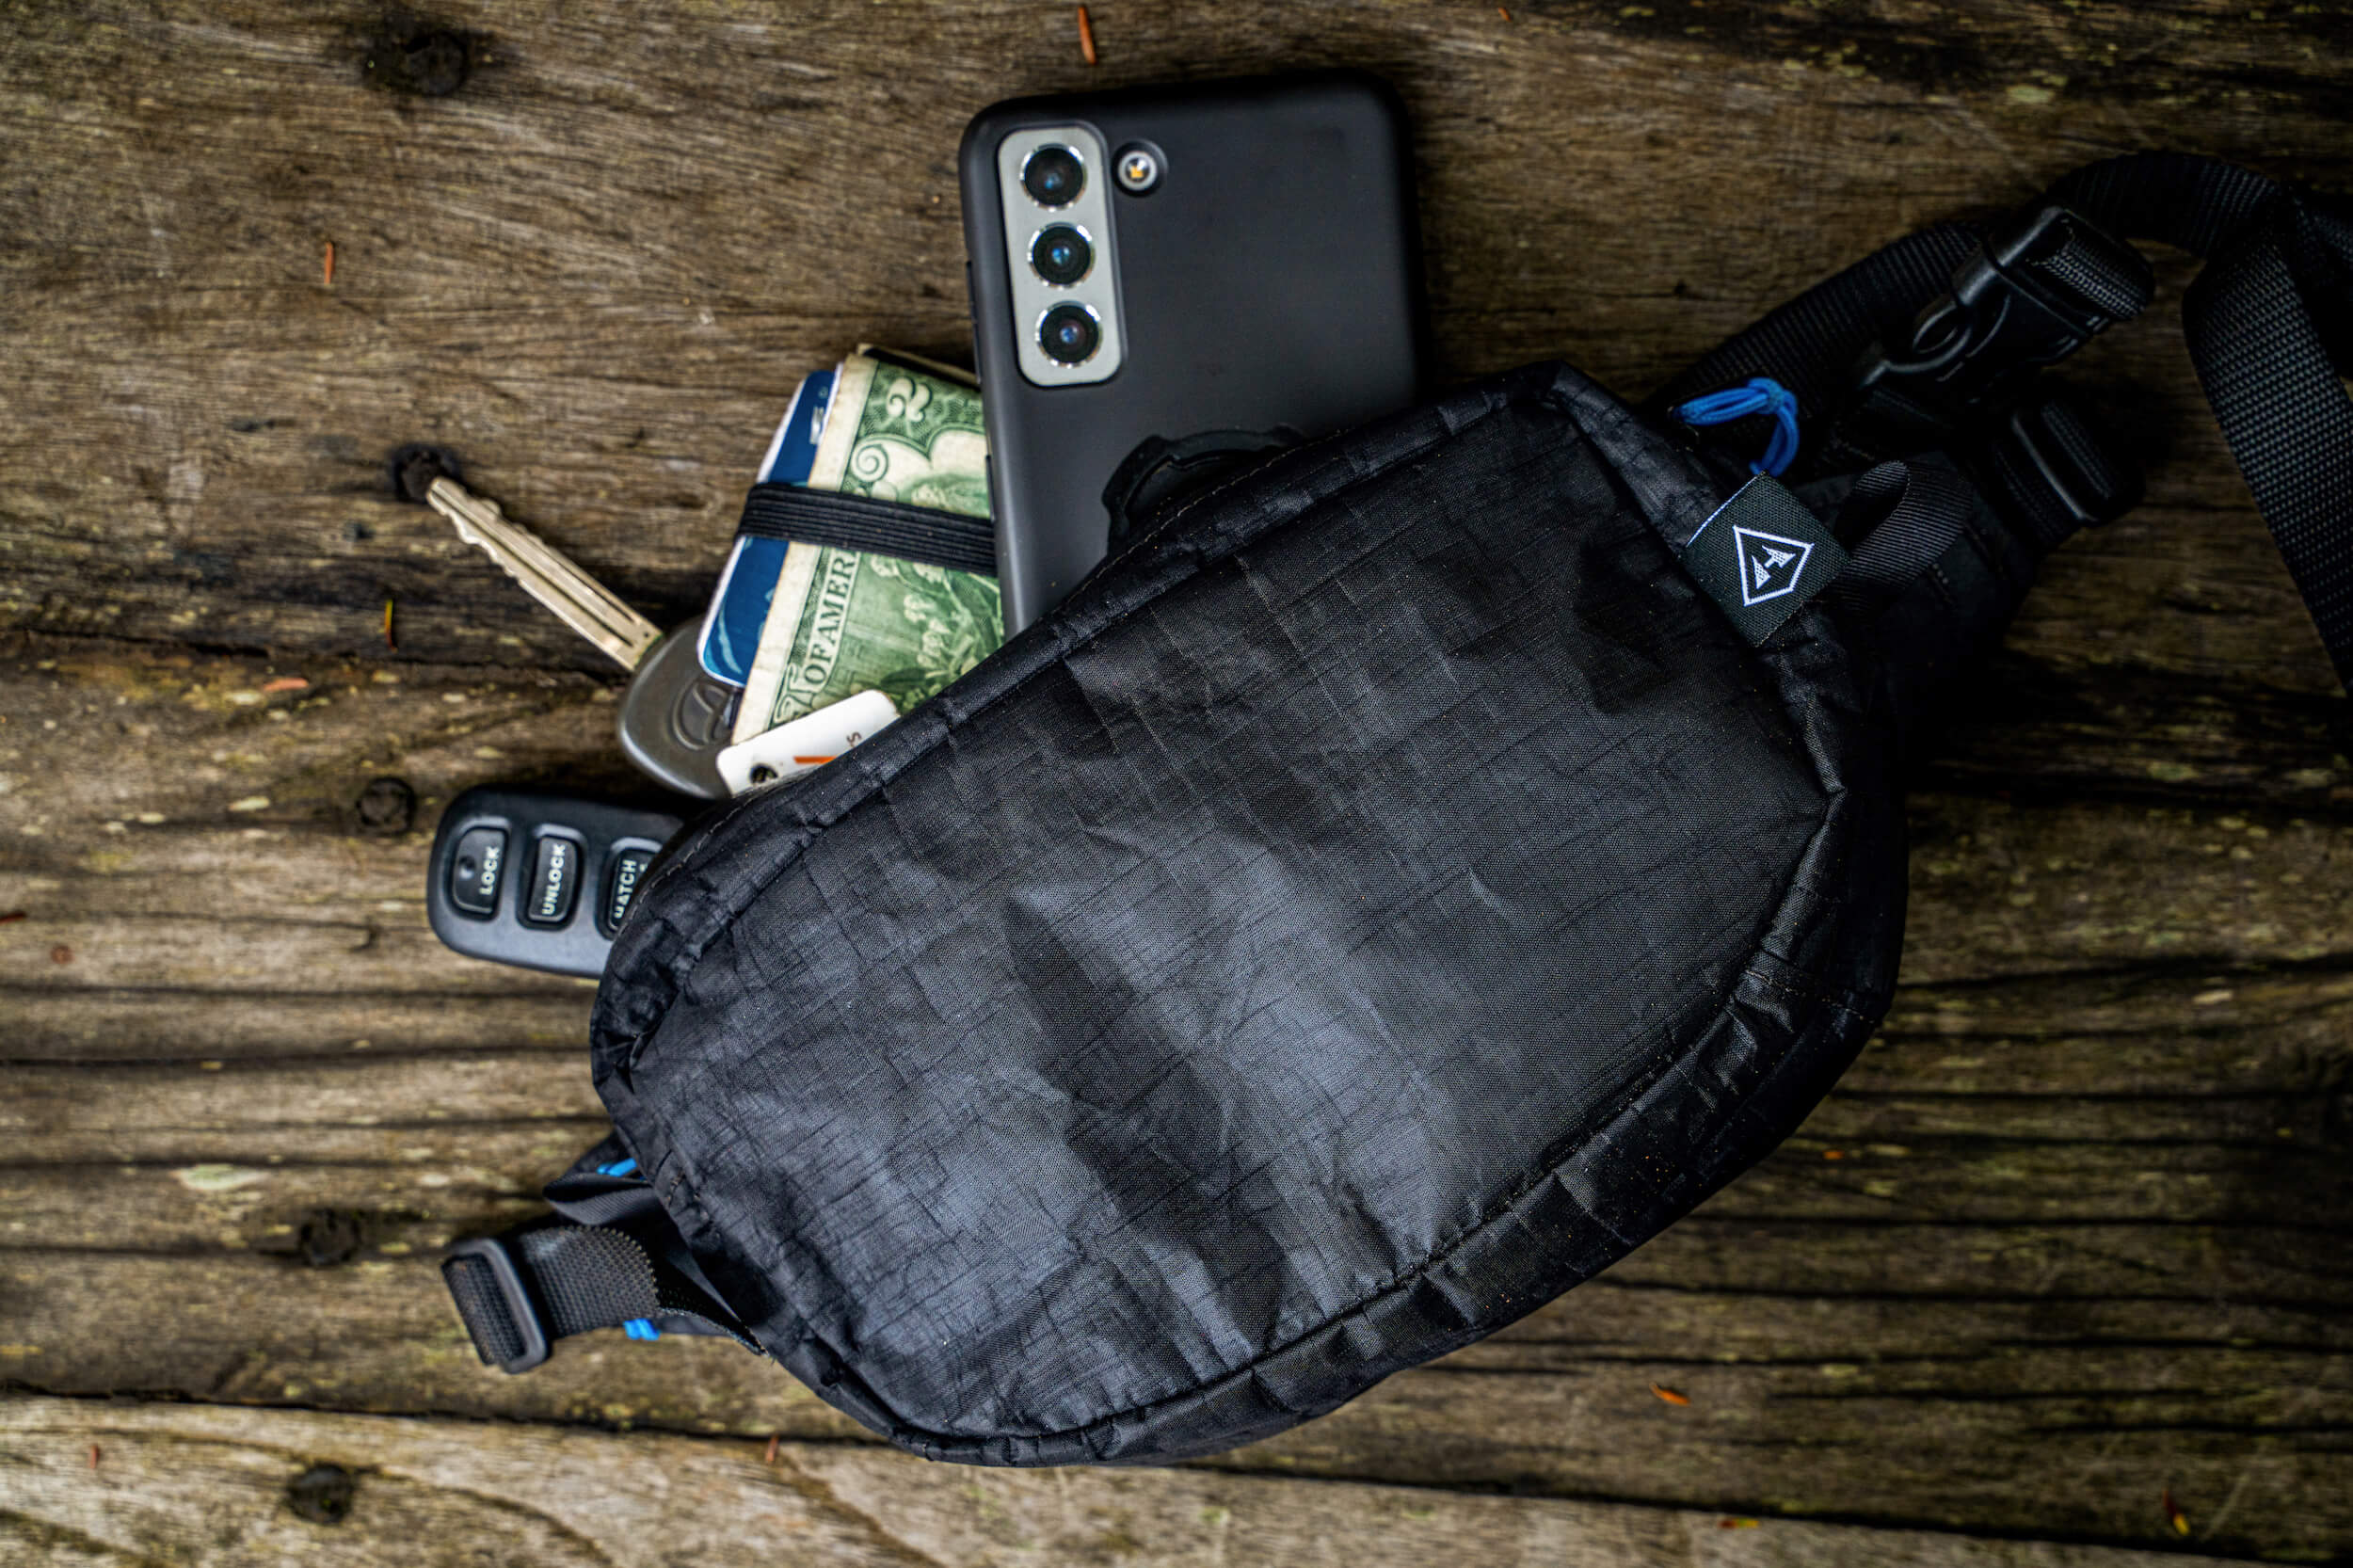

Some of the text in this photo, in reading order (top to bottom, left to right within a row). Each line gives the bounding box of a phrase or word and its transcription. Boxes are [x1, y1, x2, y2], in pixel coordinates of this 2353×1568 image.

[804, 643, 832, 685] OF
[479, 846, 500, 895] LOCK
[542, 843, 566, 916] UNLOCK
